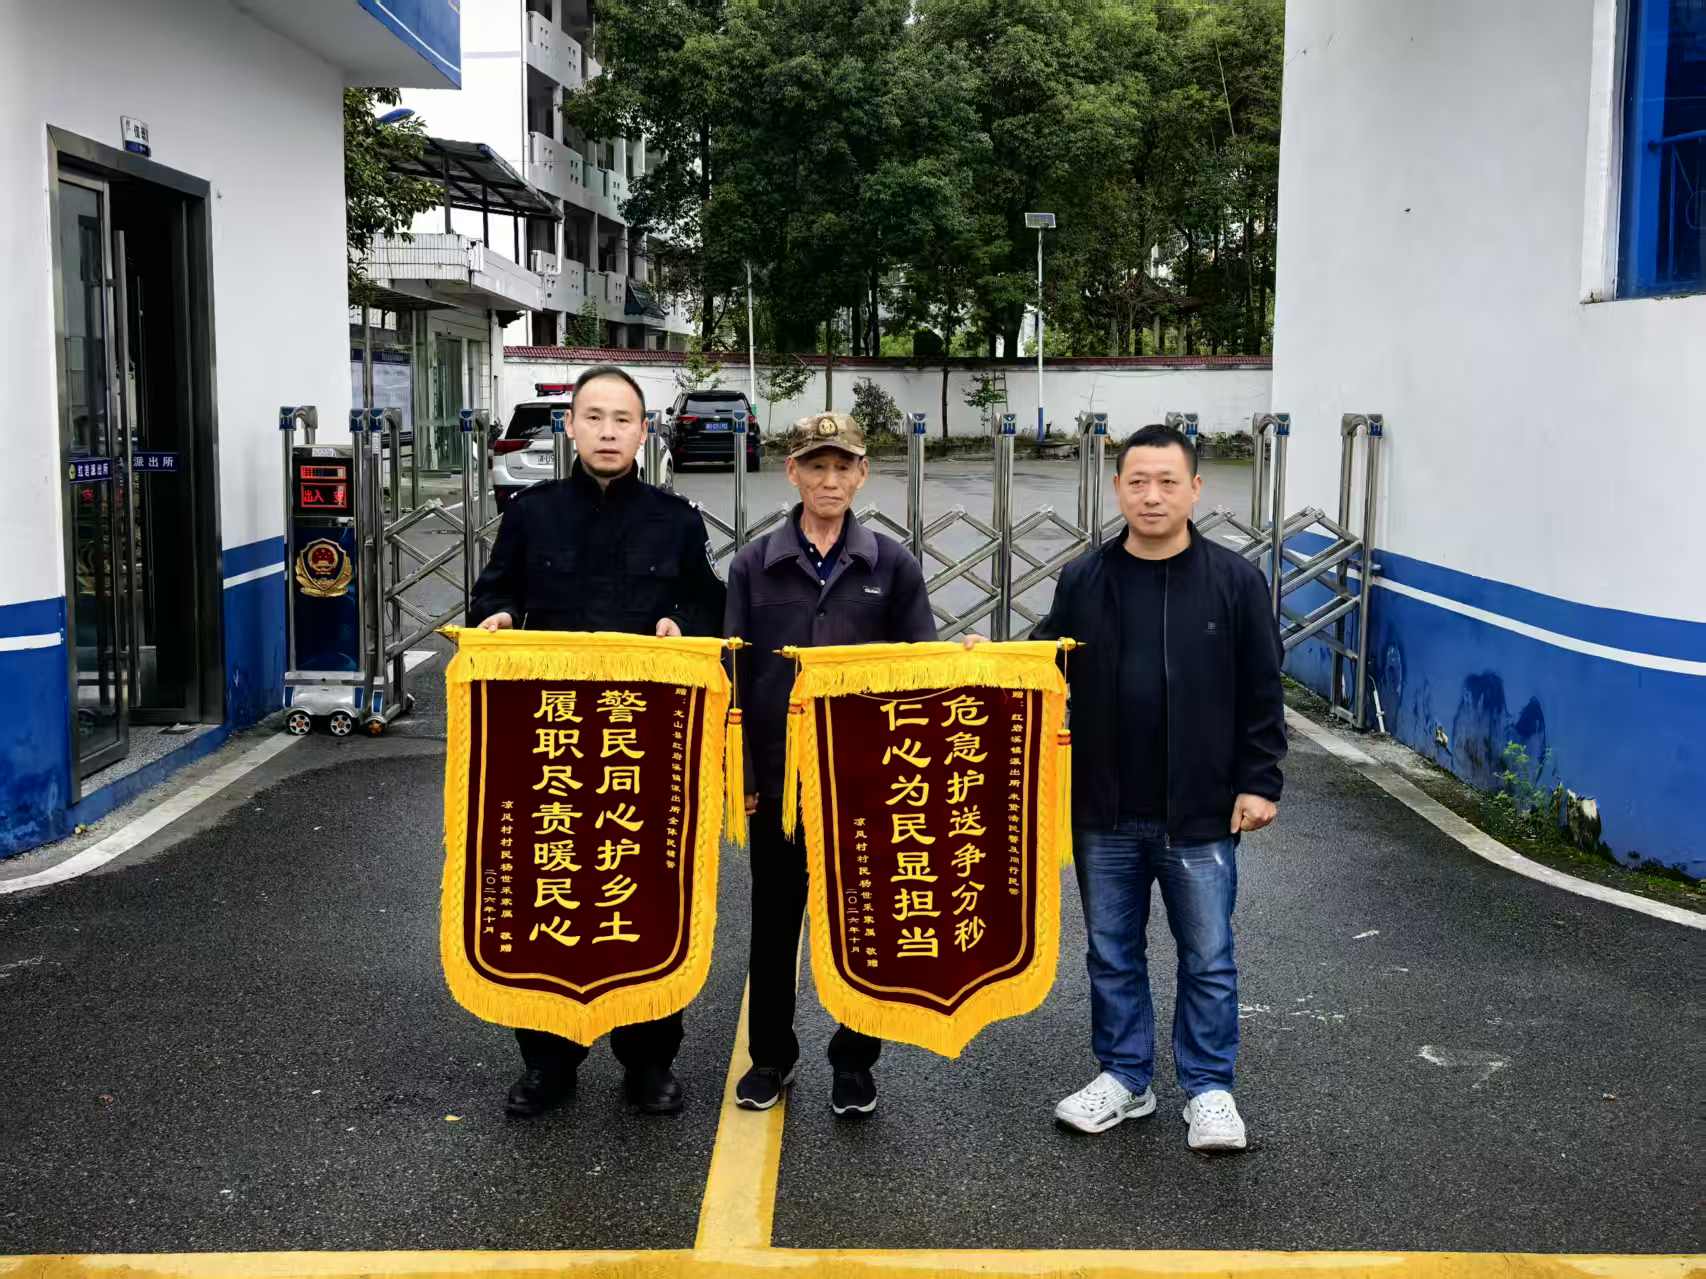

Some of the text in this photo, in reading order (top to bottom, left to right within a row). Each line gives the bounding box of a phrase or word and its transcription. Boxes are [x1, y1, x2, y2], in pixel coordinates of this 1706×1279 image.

[133, 456, 174, 468] 派出所
[529, 690, 584, 947] 履职尽责暖民心
[592, 690, 648, 945] 警民同心护乡土
[880, 699, 941, 959] 仁心为民显担当
[941, 694, 989, 953] 危急护送争分秒
